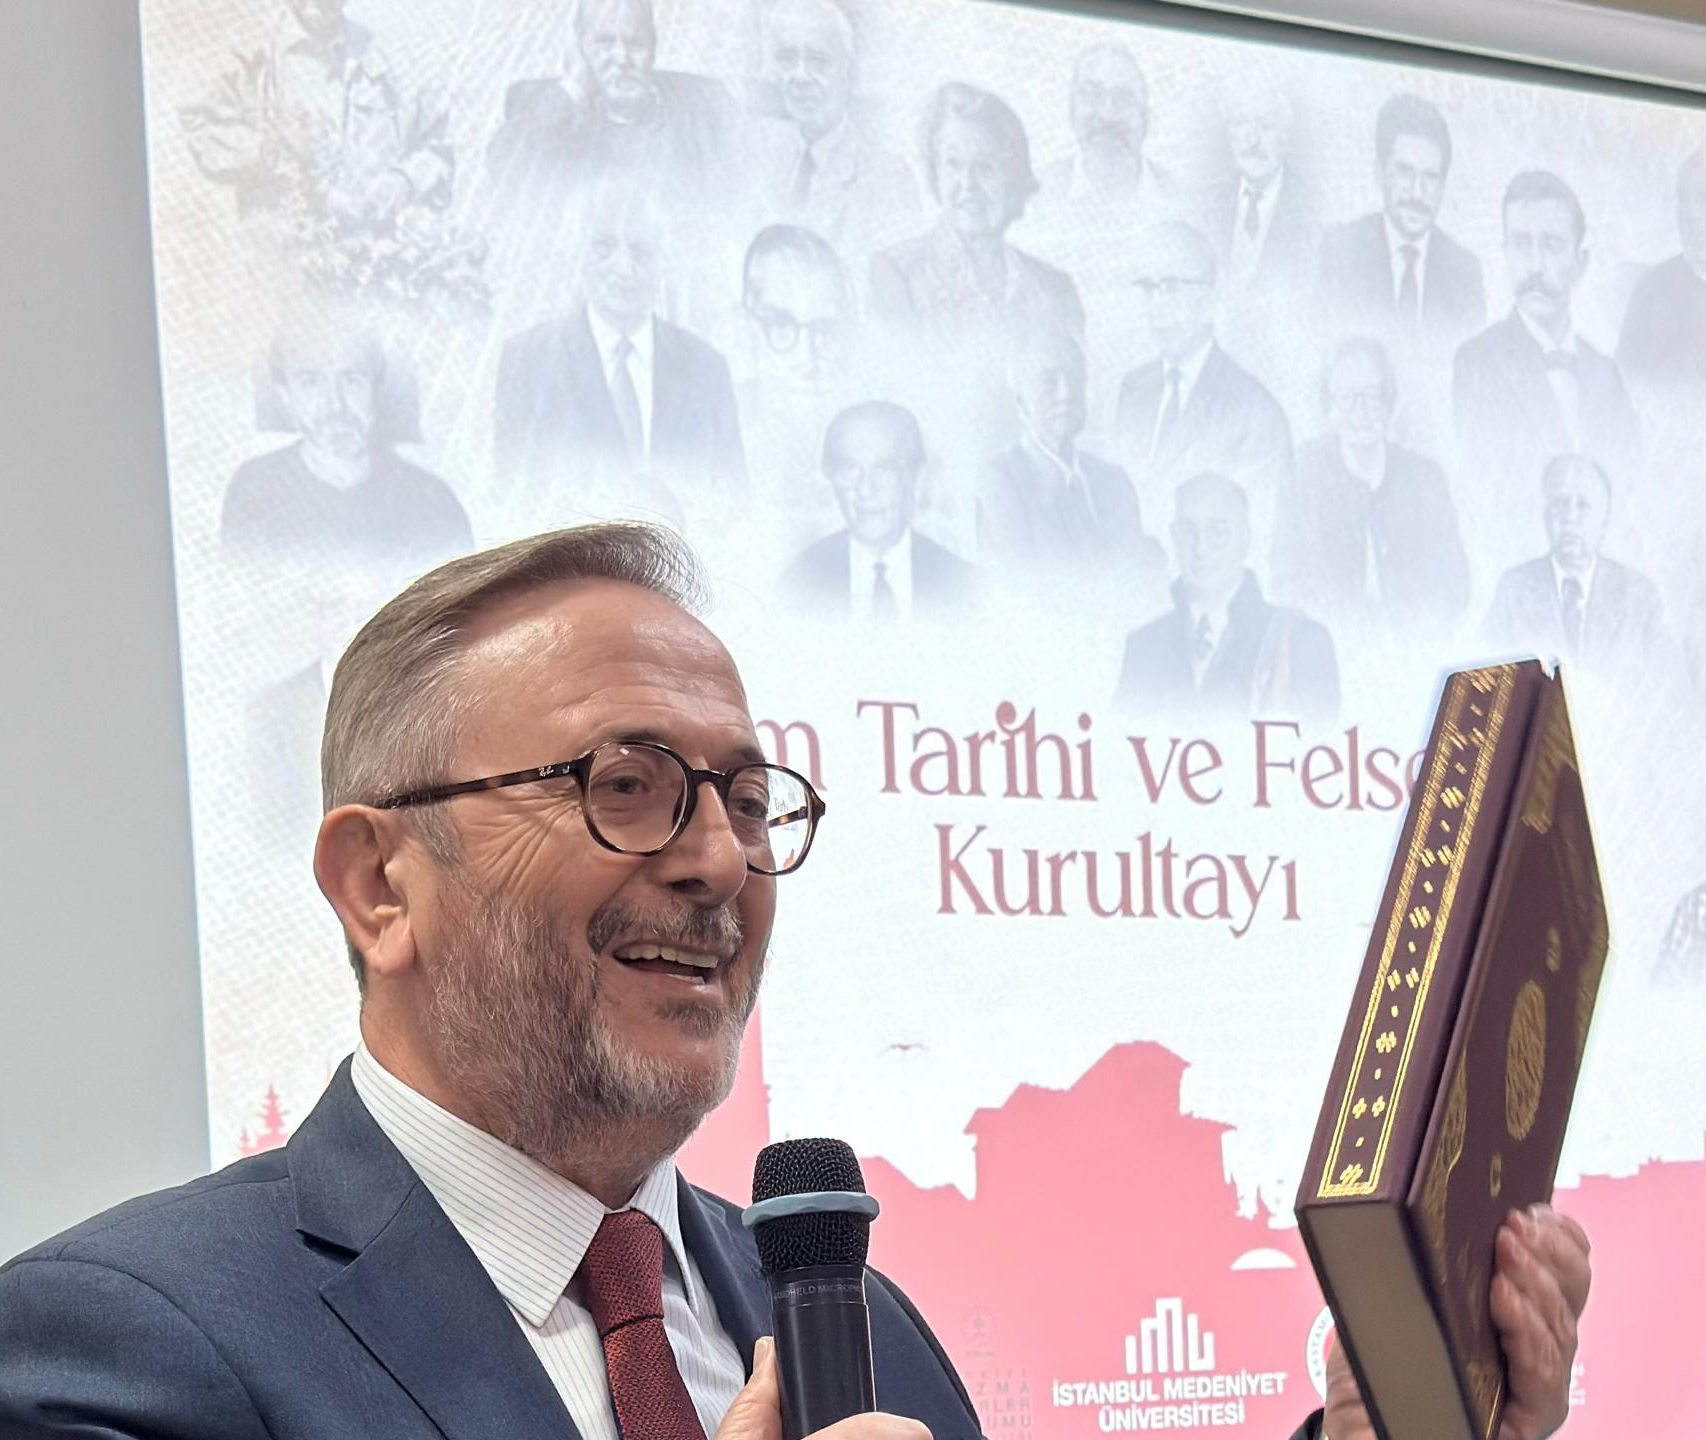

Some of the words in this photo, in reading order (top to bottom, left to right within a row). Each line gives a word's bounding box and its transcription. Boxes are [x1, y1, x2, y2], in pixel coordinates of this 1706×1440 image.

[856, 699, 1100, 802] Tarihi
[1125, 736, 1224, 806] ve
[933, 822, 1302, 940] Kurultayı
[1052, 1378, 1160, 1407] İSTANBUL
[1163, 1368, 1288, 1401] MEDENİYET
[1098, 1398, 1246, 1433] ÜNİVERSİTESİ
